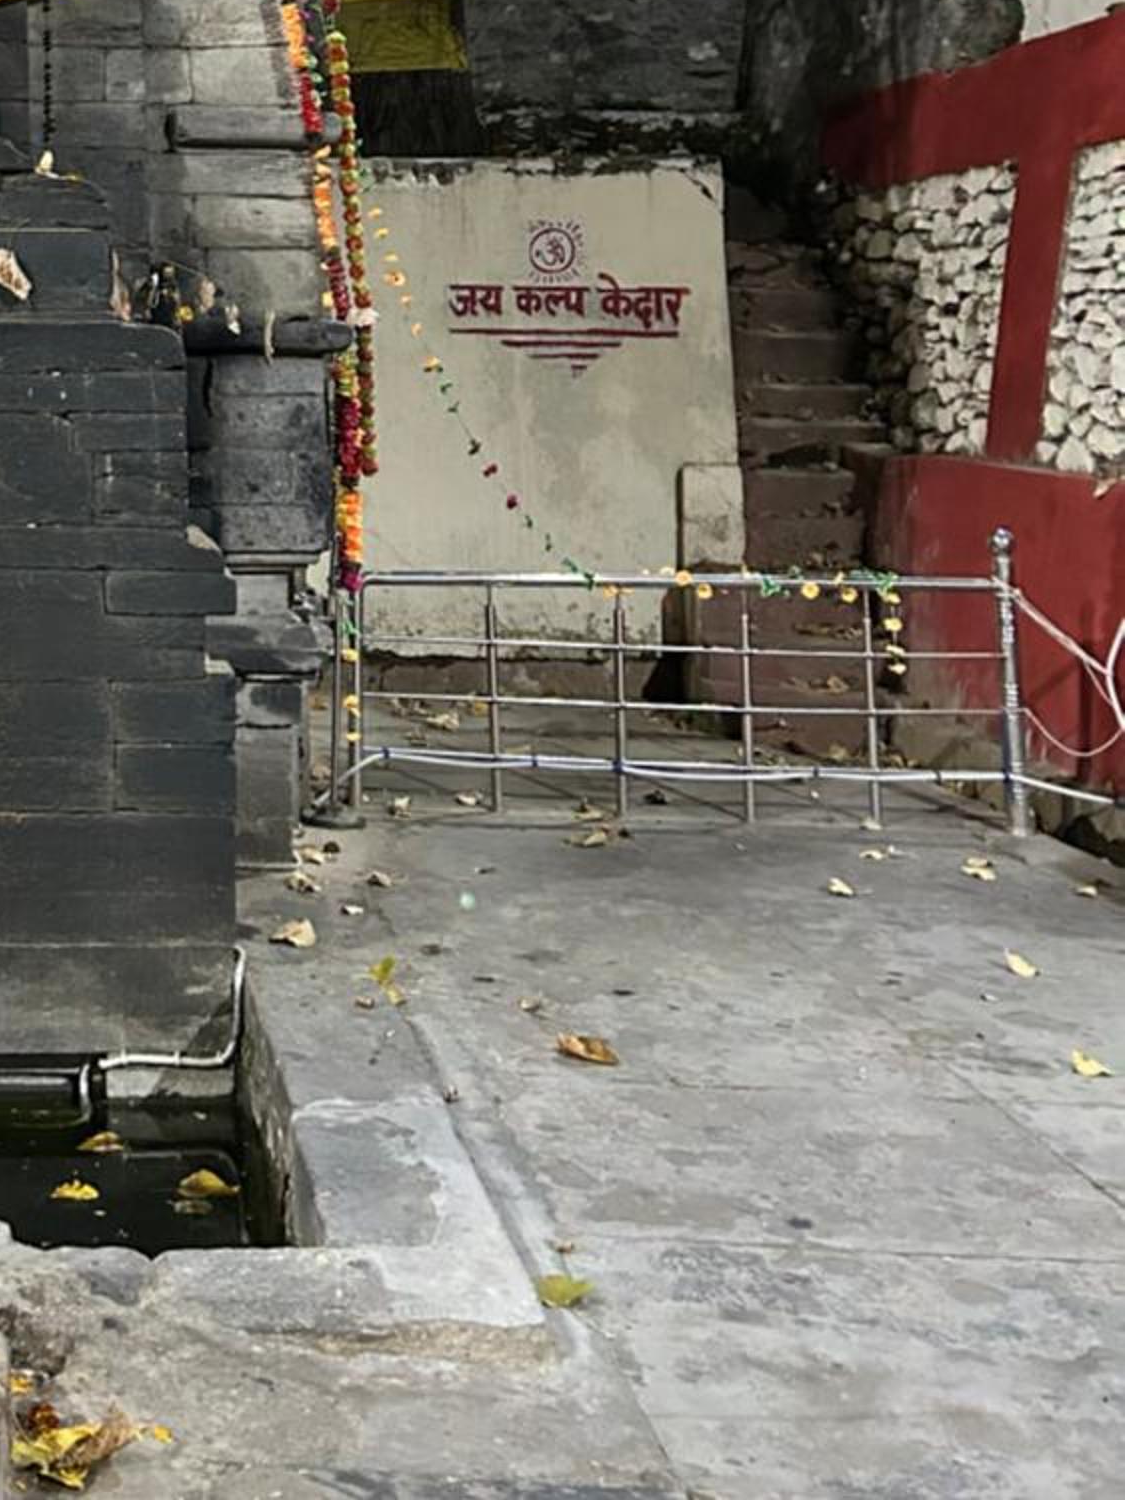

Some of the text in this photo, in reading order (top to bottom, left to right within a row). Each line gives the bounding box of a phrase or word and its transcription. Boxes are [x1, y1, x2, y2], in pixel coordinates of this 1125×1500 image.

[449, 273, 690, 328] जय कल्प केदार
